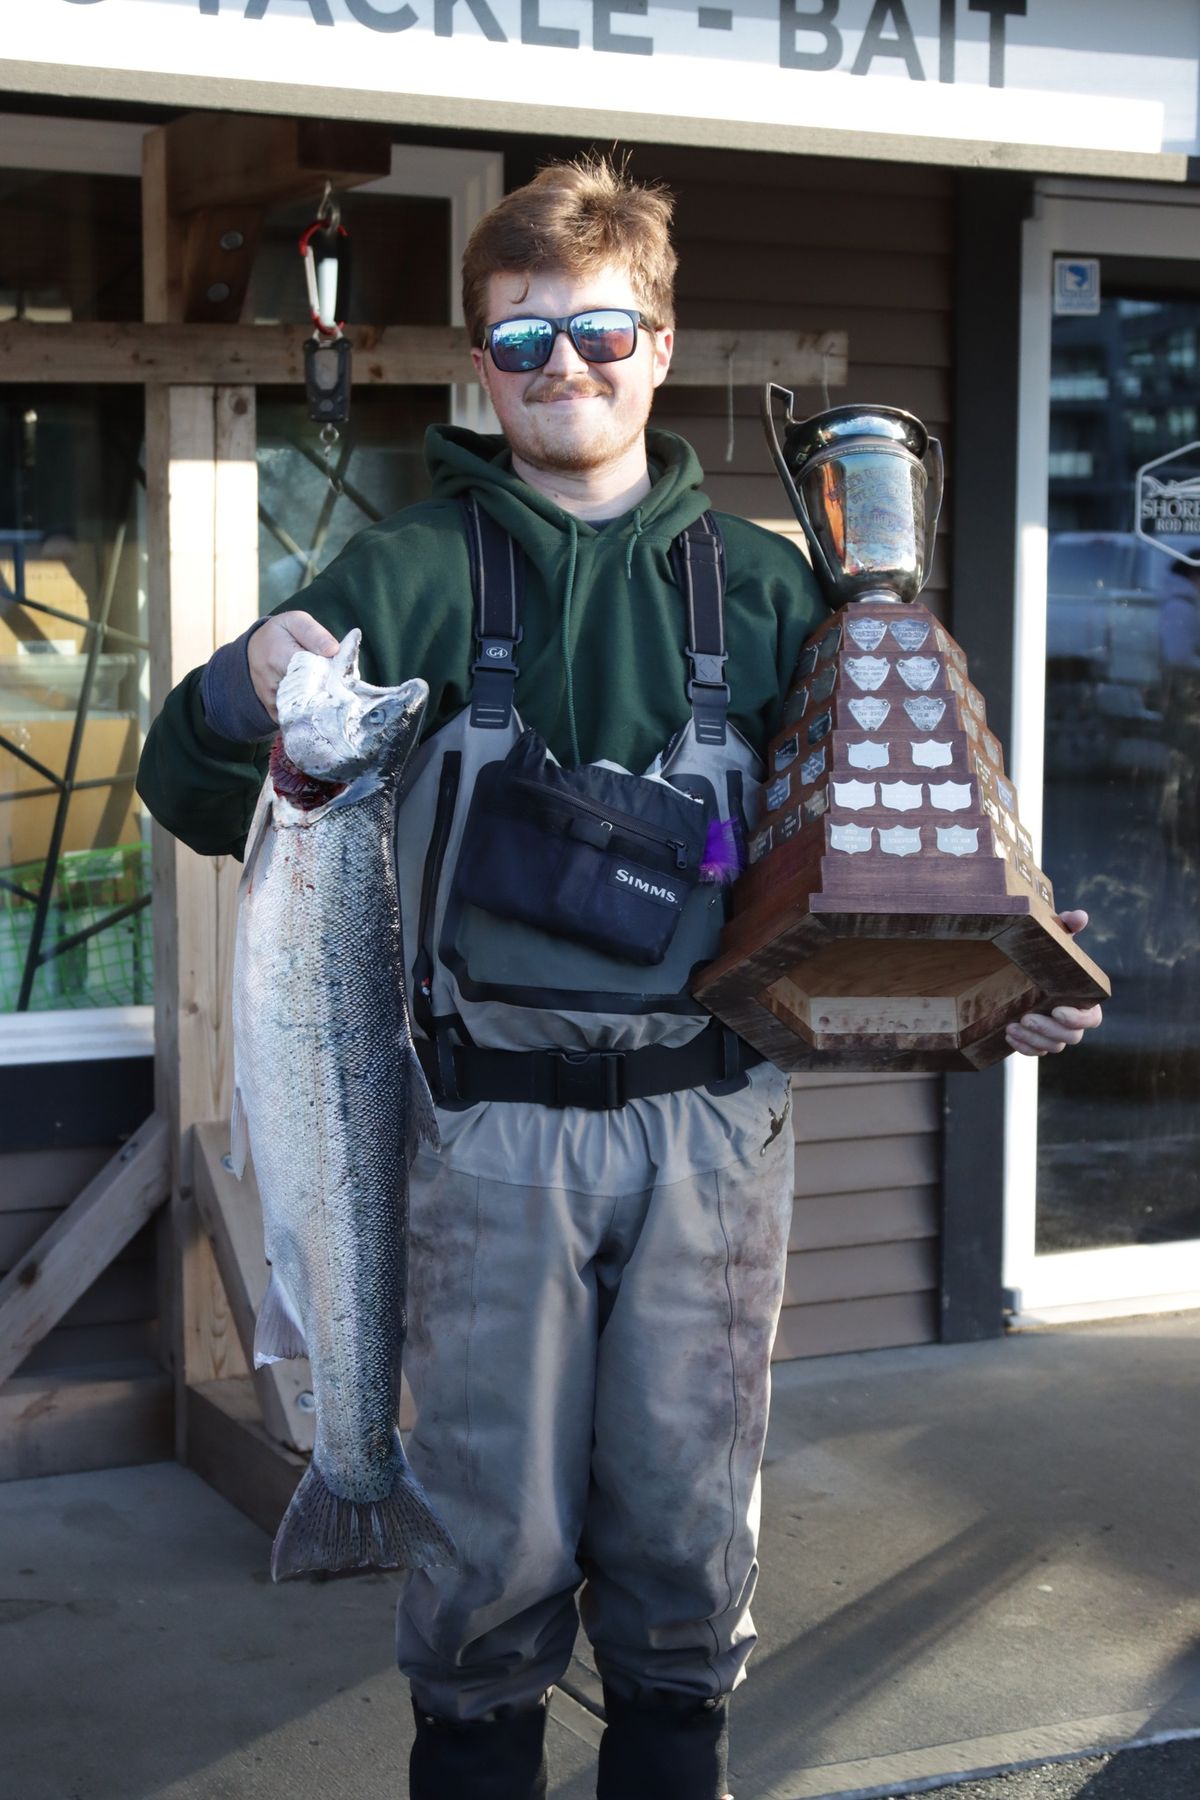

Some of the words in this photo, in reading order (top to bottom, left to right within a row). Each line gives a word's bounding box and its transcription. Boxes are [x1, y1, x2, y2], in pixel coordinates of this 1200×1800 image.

[779, 0, 1027, 88] BAIT
[1157, 519, 1182, 531] ROD
[615, 869, 677, 903] SIMMS
